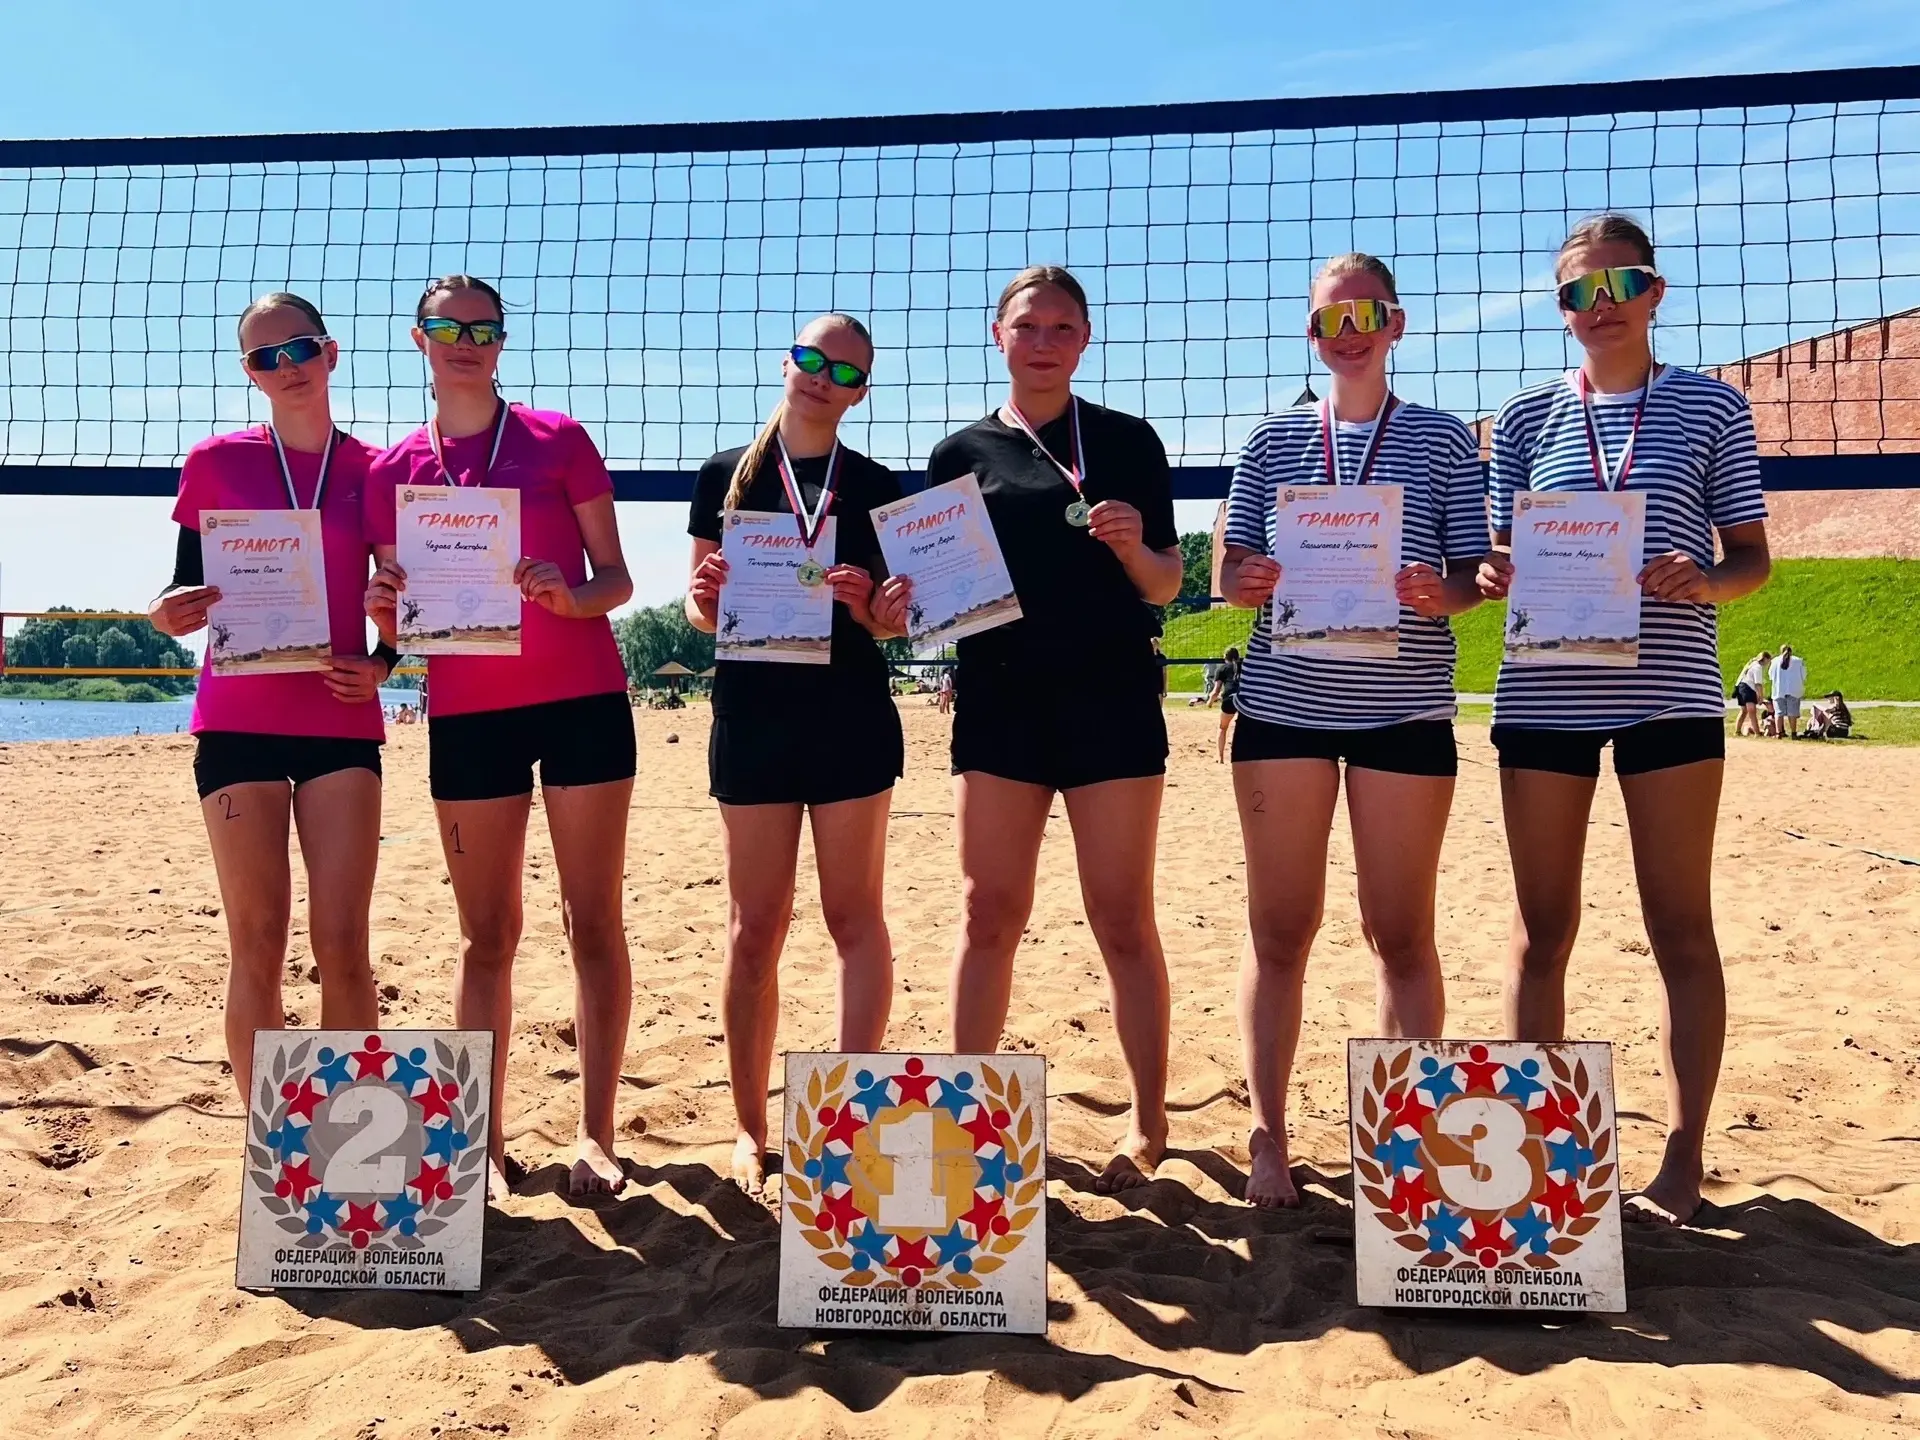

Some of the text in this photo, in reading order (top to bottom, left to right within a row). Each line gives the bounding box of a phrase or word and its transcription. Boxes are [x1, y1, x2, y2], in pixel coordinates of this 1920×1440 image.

[417, 512, 499, 529] ГРАМОТА
[896, 502, 966, 538] ГРАМОТА
[1297, 511, 1380, 528] ГРАМОТА
[1532, 520, 1620, 537] ГРАМОТА
[221, 537, 300, 552] ГРАМОТА
[742, 534, 804, 549] ГРАМОТ
[1537, 548, 1604, 561] Иванова Мария
[218, 793, 240, 820] 2
[1252, 790, 1265, 813] 2
[450, 822, 465, 854] 1
[322, 1085, 409, 1194] 2
[1436, 1097, 1533, 1211] 3
[878, 1111, 947, 1228] 1
[274, 1247, 444, 1266] ФЕДЕРАЦИЯ ВОЛЕЙБОЛА
[271, 1267, 446, 1286] НОВГОРОДСКОЙ ОБЛАСТИ
[1396, 1266, 1583, 1287] ФЕДЕРАЦИЯ ВОЛЕЙБОЛА
[818, 1286, 1004, 1306] ФЕДЕРАЦИЯ ВОЛЕЙБОЛА
[1395, 1287, 1588, 1308] НОВГОРОДСКОЙ ОБЛАСТИ
[815, 1306, 1007, 1328] НОВГОРОДСКОЙ ОБЛАСТИ
